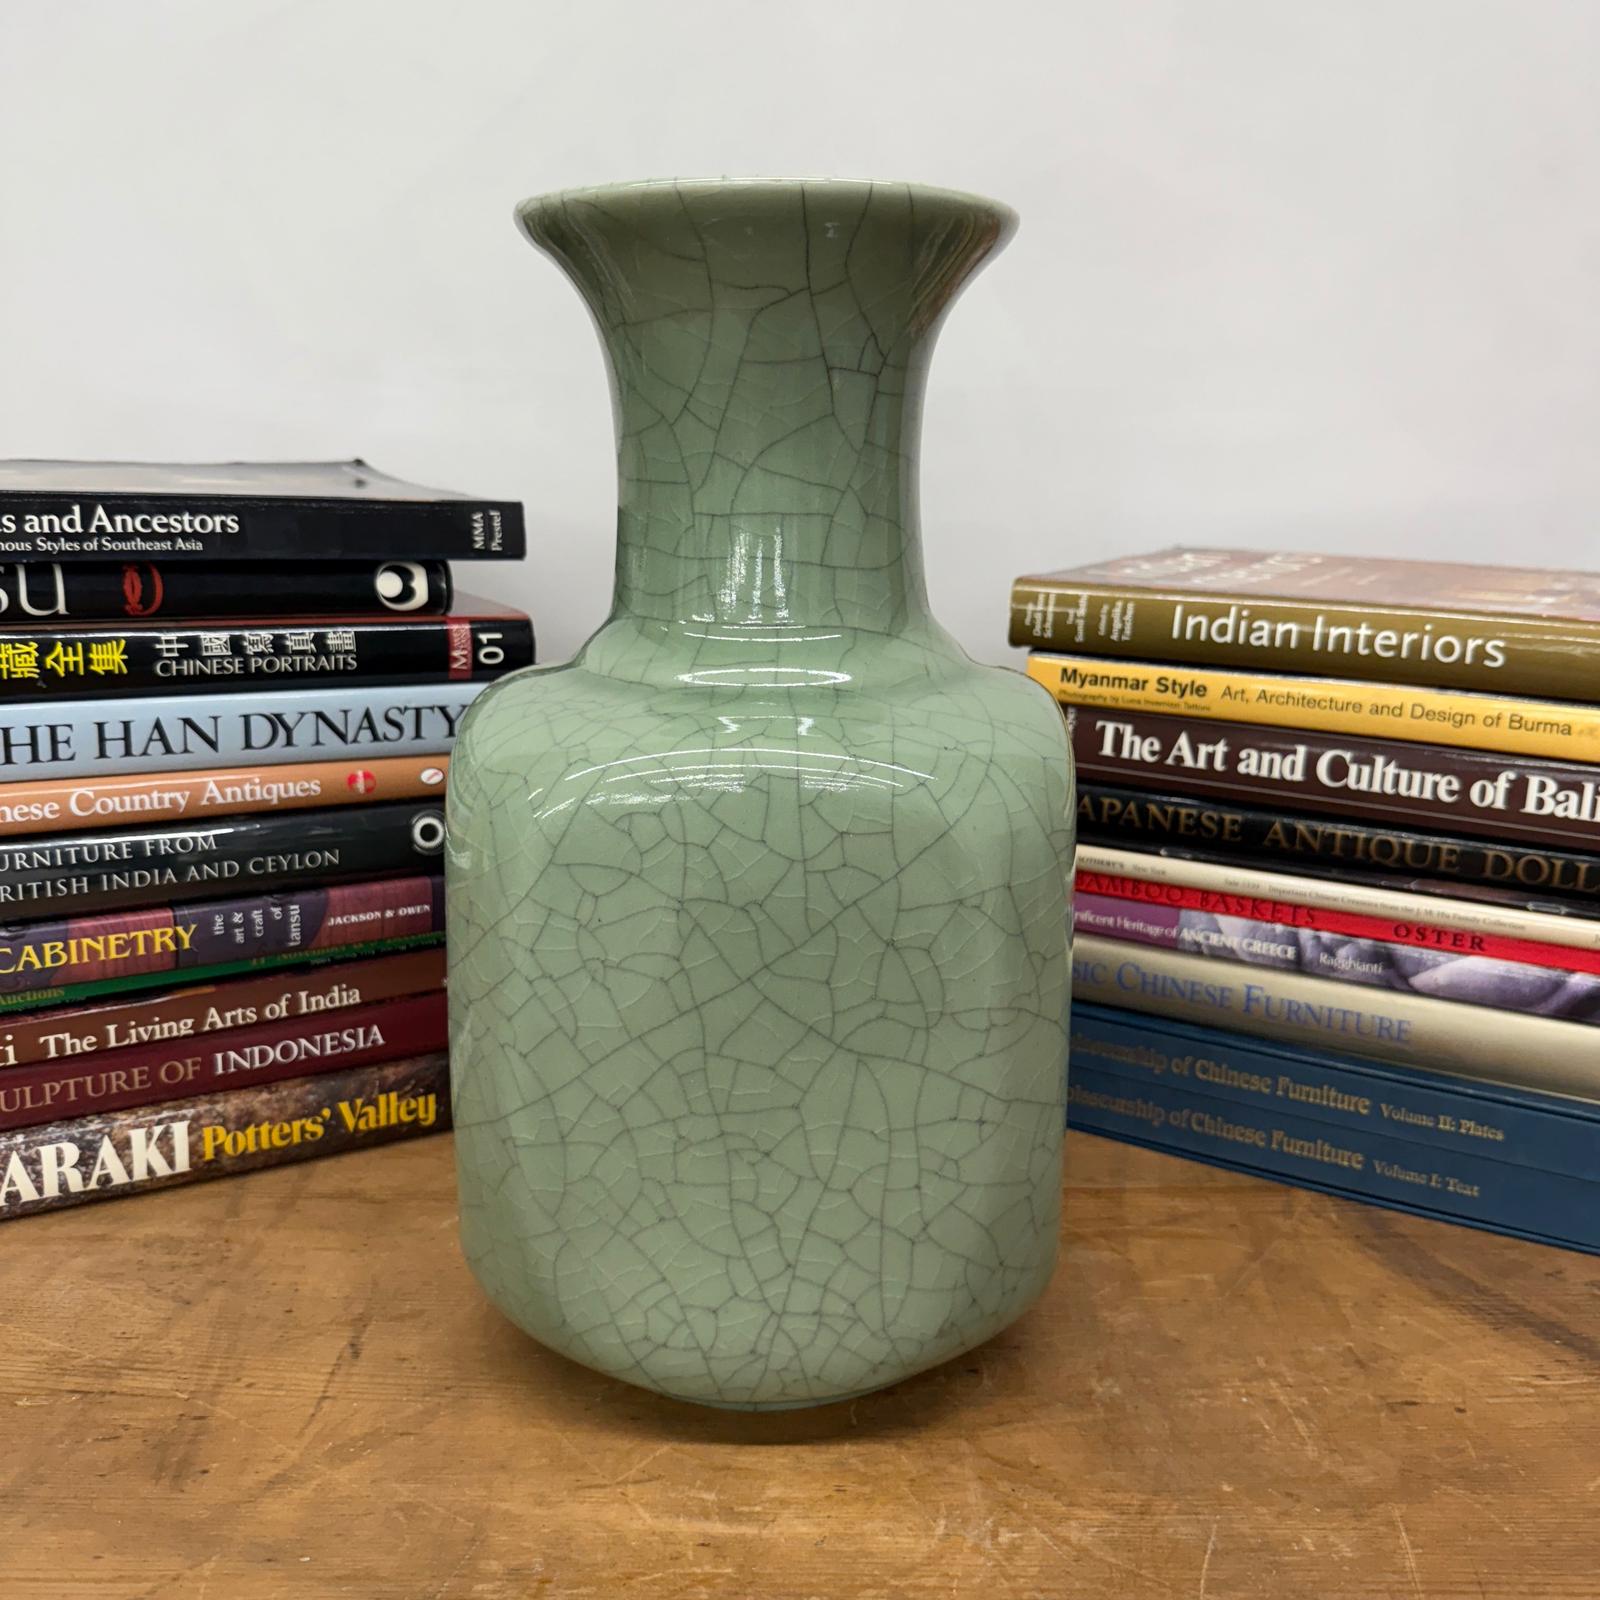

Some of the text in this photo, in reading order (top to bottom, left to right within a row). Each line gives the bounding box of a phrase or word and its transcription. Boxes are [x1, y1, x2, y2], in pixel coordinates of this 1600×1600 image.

[0, 504, 240, 534] s and Ancestors
[472, 511, 485, 550] MMA
[489, 510, 503, 551] Prestel
[36, 537, 81, 554] Styles
[83, 537, 99, 551] of
[102, 537, 172, 551] Southeast
[175, 538, 203, 551] Asia
[477, 632, 504, 664] 01
[1172, 604, 1505, 668] Indian Interiors
[155, 653, 358, 678] CHINESE PORTRAITS
[1060, 667, 1149, 692] Myanmar
[1156, 676, 1208, 699] Style
[1221, 686, 1249, 704] Art,
[1255, 688, 1362, 714] Architecture
[1369, 702, 1403, 718] and
[1410, 704, 1475, 729] Design
[1483, 715, 1502, 728] of
[1508, 714, 1572, 736] Burma
[0, 704, 468, 766] HE HAN DYNASTY
[1096, 720, 1162, 763] The
[1165, 731, 1229, 772] Art
[1237, 742, 1306, 783] and
[1316, 749, 1461, 803] Culture
[1470, 770, 1516, 810] of
[69, 788, 190, 817] Country
[200, 778, 321, 806] Antiques
[145, 834, 217, 857] FROM
[1077, 795, 1600, 891] APANESE ANTIQUE DOLL
[0, 849, 341, 902] RITISH INDIA AND CEYLON
[212, 913, 225, 936] the
[232, 911, 245, 944] art &
[251, 909, 264, 937] craft
[270, 906, 283, 920] of
[287, 904, 301, 947] tansu
[327, 904, 431, 927] JACKSON & OWEN
[1200, 892, 1315, 925] BASKETS
[0, 924, 198, 974] CABINETRY
[1116, 915, 1164, 938] Heritage
[1165, 926, 1179, 939] of
[1241, 937, 1297, 961] GREECE
[1393, 924, 1486, 951] OSTER
[39, 1032, 98, 1059] The
[105, 1016, 195, 1049] Living
[202, 1006, 257, 1032] Arts
[265, 993, 291, 1020] of
[299, 983, 362, 1015] India
[0, 1024, 386, 1113] ULPTURE OF INDONESIA
[1171, 1055, 1195, 1075] of
[1195, 1059, 1271, 1095] Chinese
[1276, 1076, 1370, 1115] Furniture
[1380, 1103, 1435, 1128] Volume
[1438, 1115, 1455, 1133] II:
[1459, 1119, 1505, 1142] Plates
[0, 1120, 193, 1207] ARAKI
[337, 1090, 437, 1134] Valley
[1169, 1108, 1191, 1128] of
[1191, 1113, 1266, 1147] Chinese
[1271, 1130, 1364, 1169] Furniture
[1373, 1159, 1426, 1186] Volume
[1446, 1176, 1480, 1198] Text
